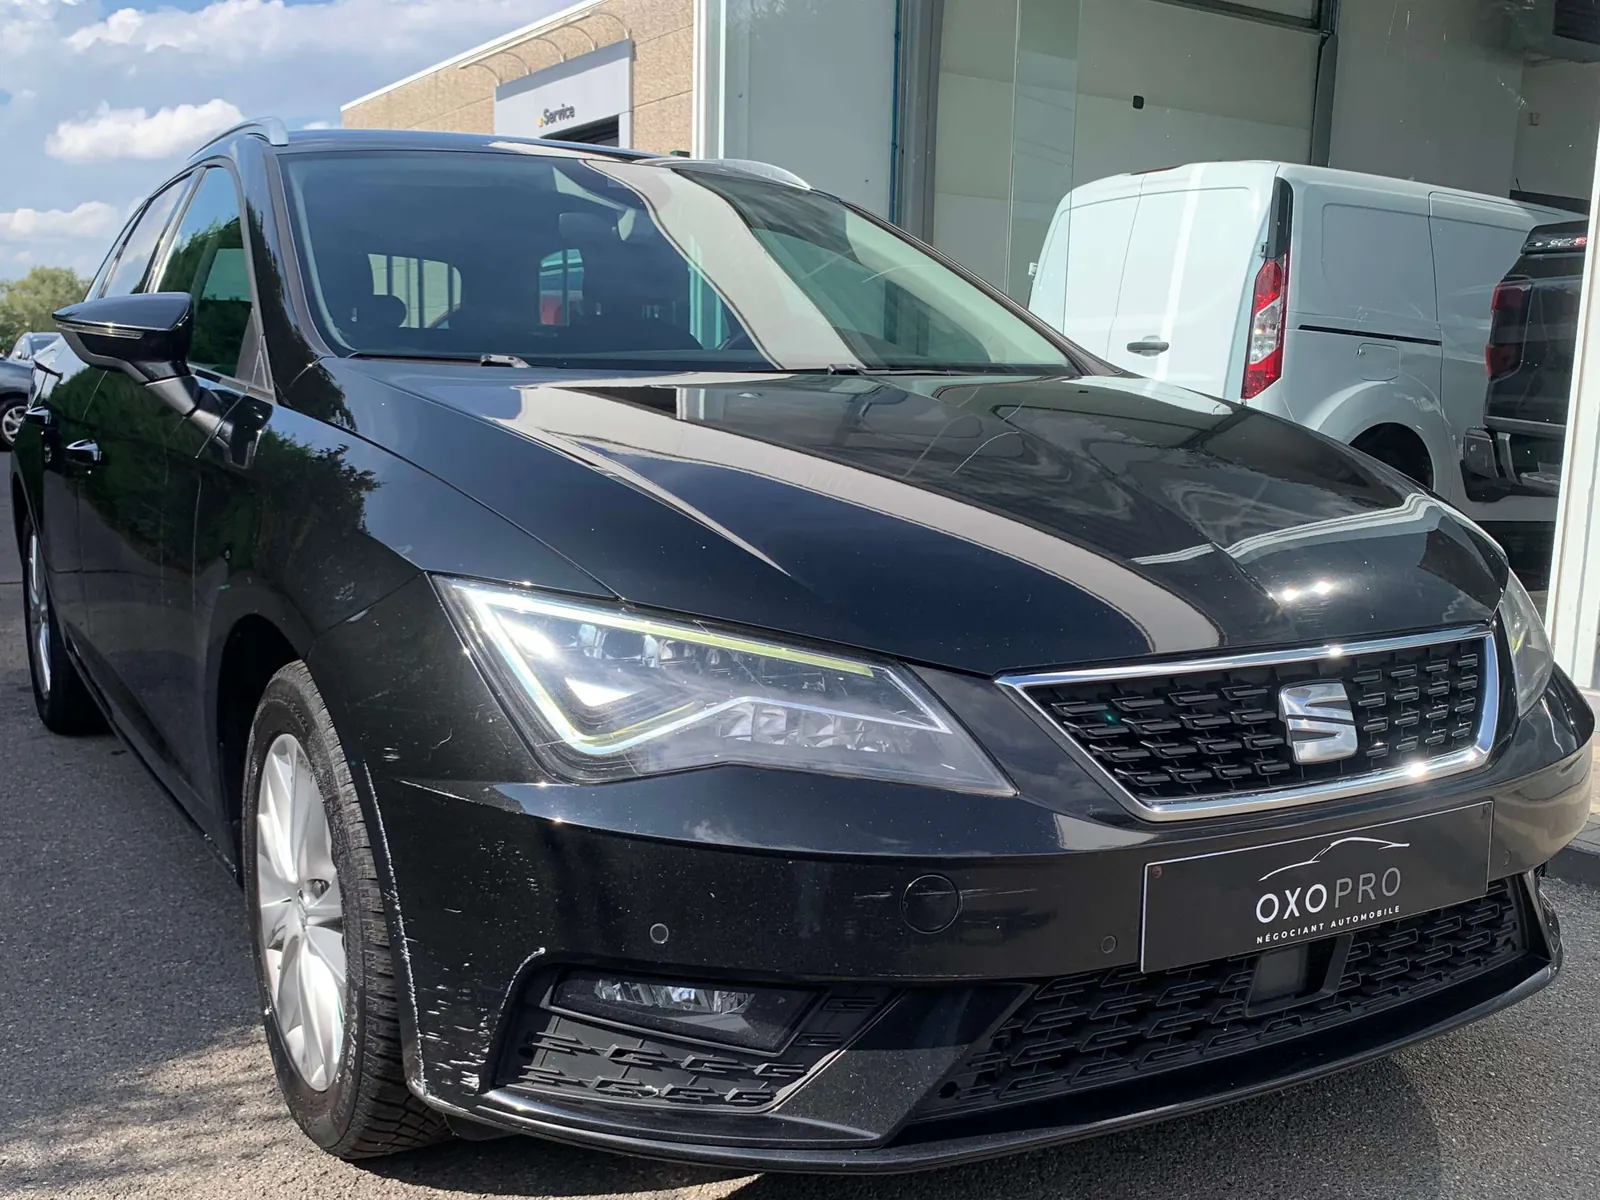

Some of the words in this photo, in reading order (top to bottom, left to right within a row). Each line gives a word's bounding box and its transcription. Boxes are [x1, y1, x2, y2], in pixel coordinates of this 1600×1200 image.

[543, 103, 575, 126] Service
[1256, 922, 1325, 944] NÉGOCIANT
[1330, 905, 1401, 929] AUTOMOBILE
